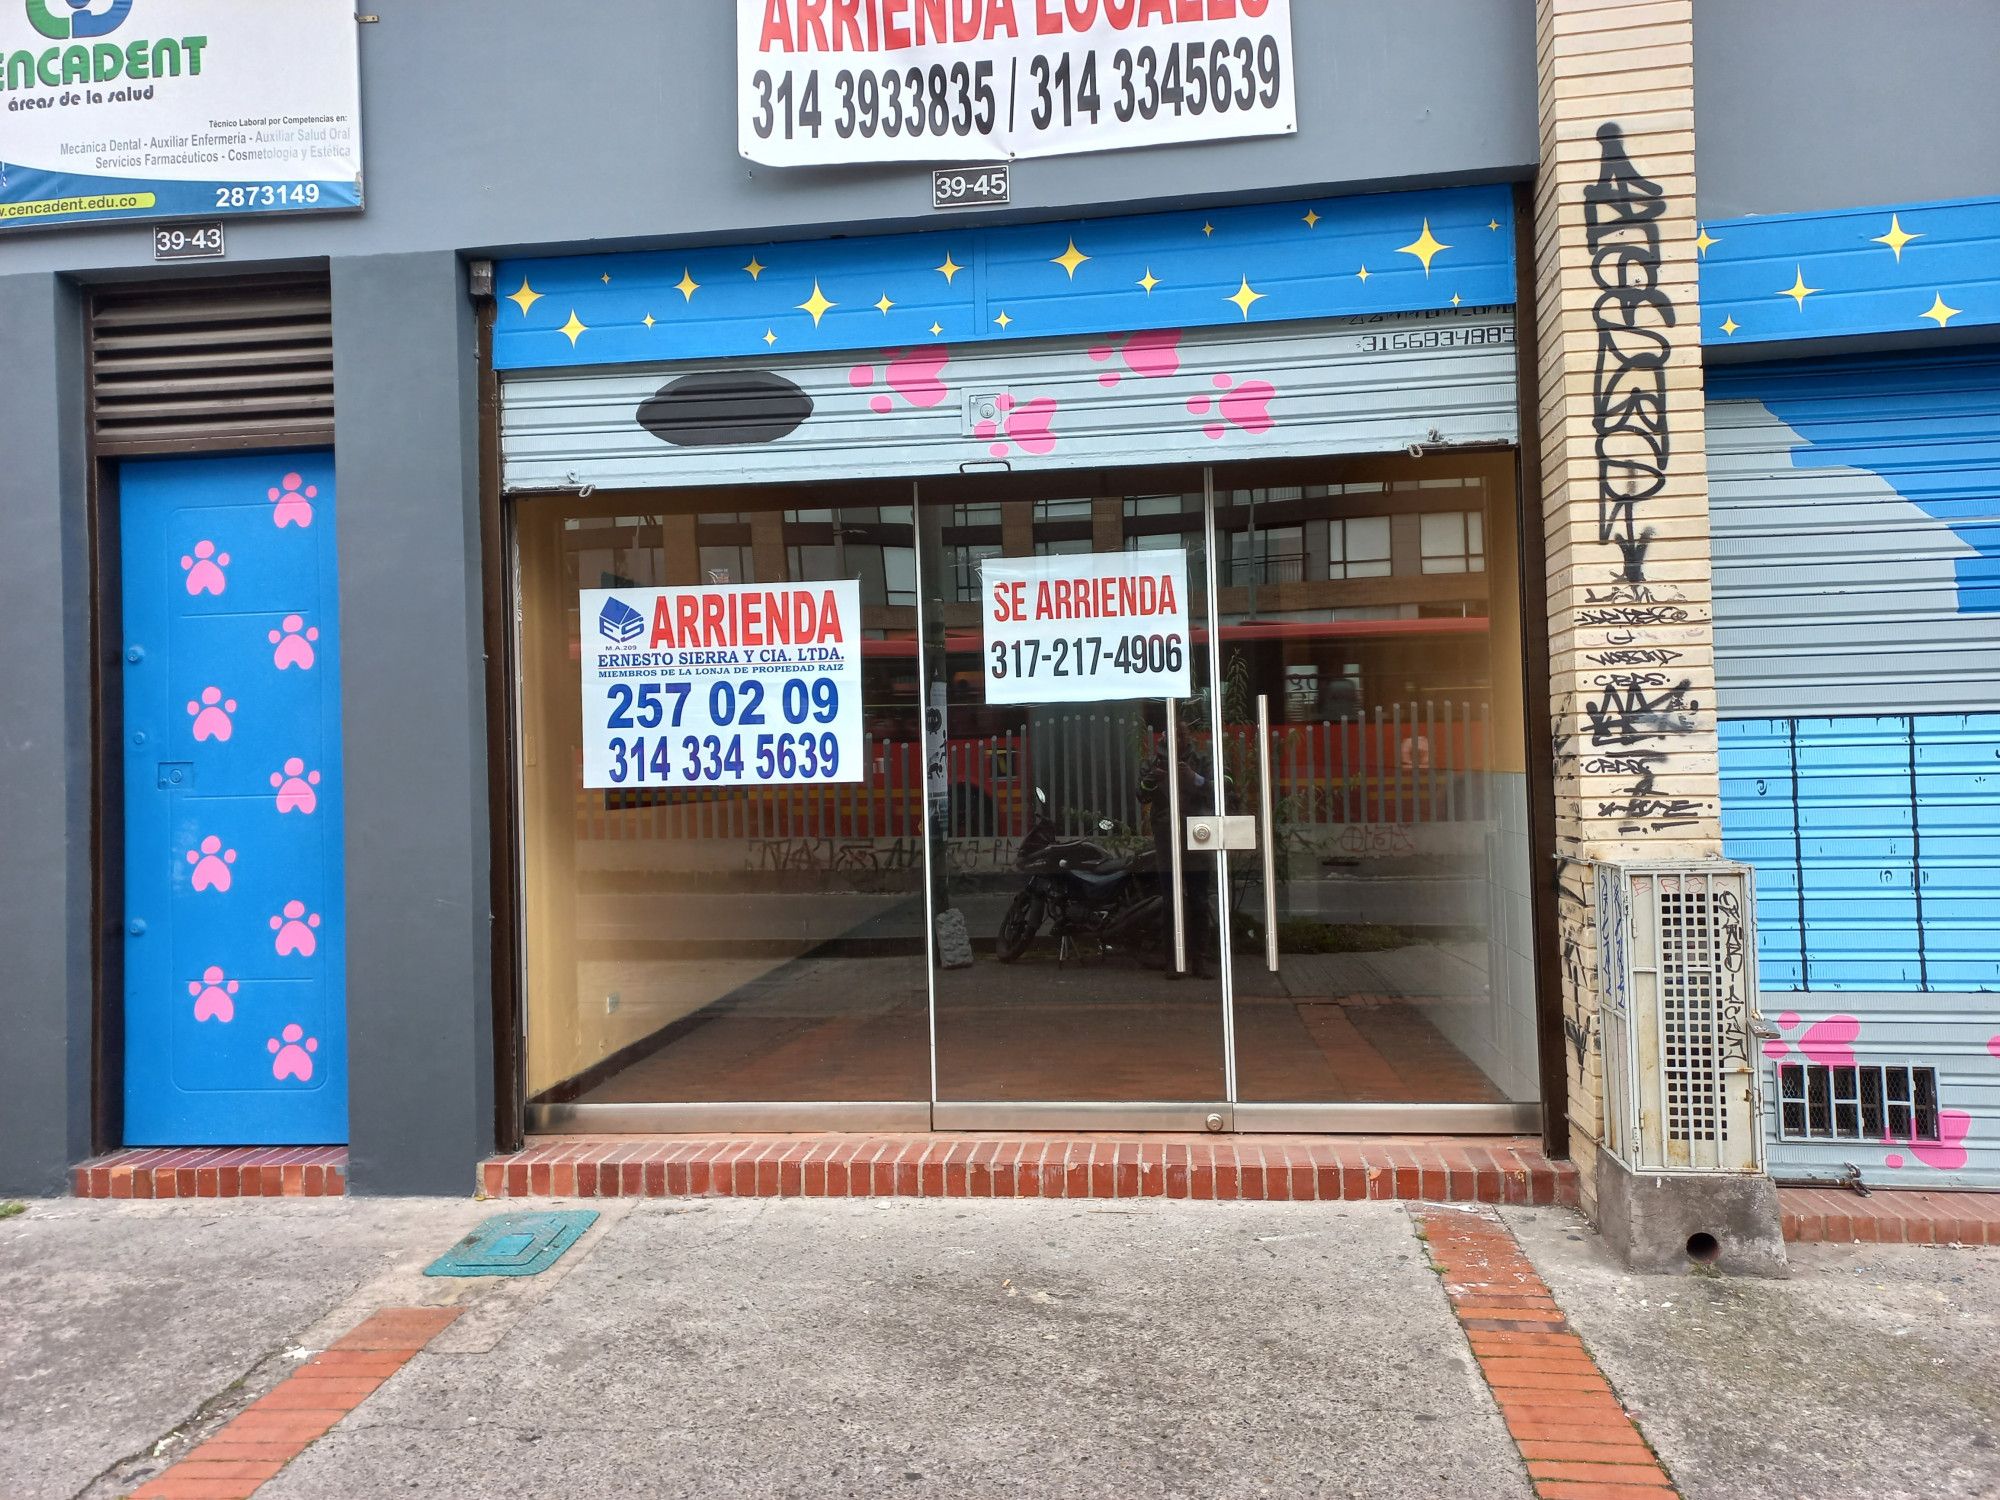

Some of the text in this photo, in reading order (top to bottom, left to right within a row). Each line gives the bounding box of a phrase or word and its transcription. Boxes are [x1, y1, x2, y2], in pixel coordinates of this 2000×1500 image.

[0, 36, 207, 91] NCADENT
[8, 85, 154, 111] áreas de la salud
[752, 69, 821, 140] 314
[835, 60, 995, 139] 3933835
[1029, 50, 1100, 130] 314
[1113, 34, 1280, 123] 3345639
[239, 117, 267, 127] Laboral
[268, 118, 281, 127] por
[283, 115, 334, 125] Competencias
[335, 115, 348, 123] en:
[109, 138, 141, 151] Dental
[150, 135, 188, 149] Auxiliar
[255, 129, 294, 143] Auxiliar
[297, 127, 326, 141] Salud
[329, 127, 350, 140] Oral
[95, 155, 141, 169] Servicios
[301, 150, 308, 161] y
[215, 183, 320, 208] 2873149
[936, 173, 1007, 199] 39-45
[156, 228, 222, 251] 39-43
[993, 575, 1177, 622] SE ARRIENDA
[650, 590, 843, 649] ARRIENDA
[598, 647, 844, 667] ERNESTO SIERRA Y CIA. LTDA.
[991, 633, 1182, 679] 317-217-4906
[598, 669, 657, 678] MIEMBROS
[696, 667, 730, 675] LONJA
[752, 664, 815, 673] PROPIEDAD
[607, 678, 839, 729] 257 02 09
[608, 732, 839, 782] 314 334 5639
